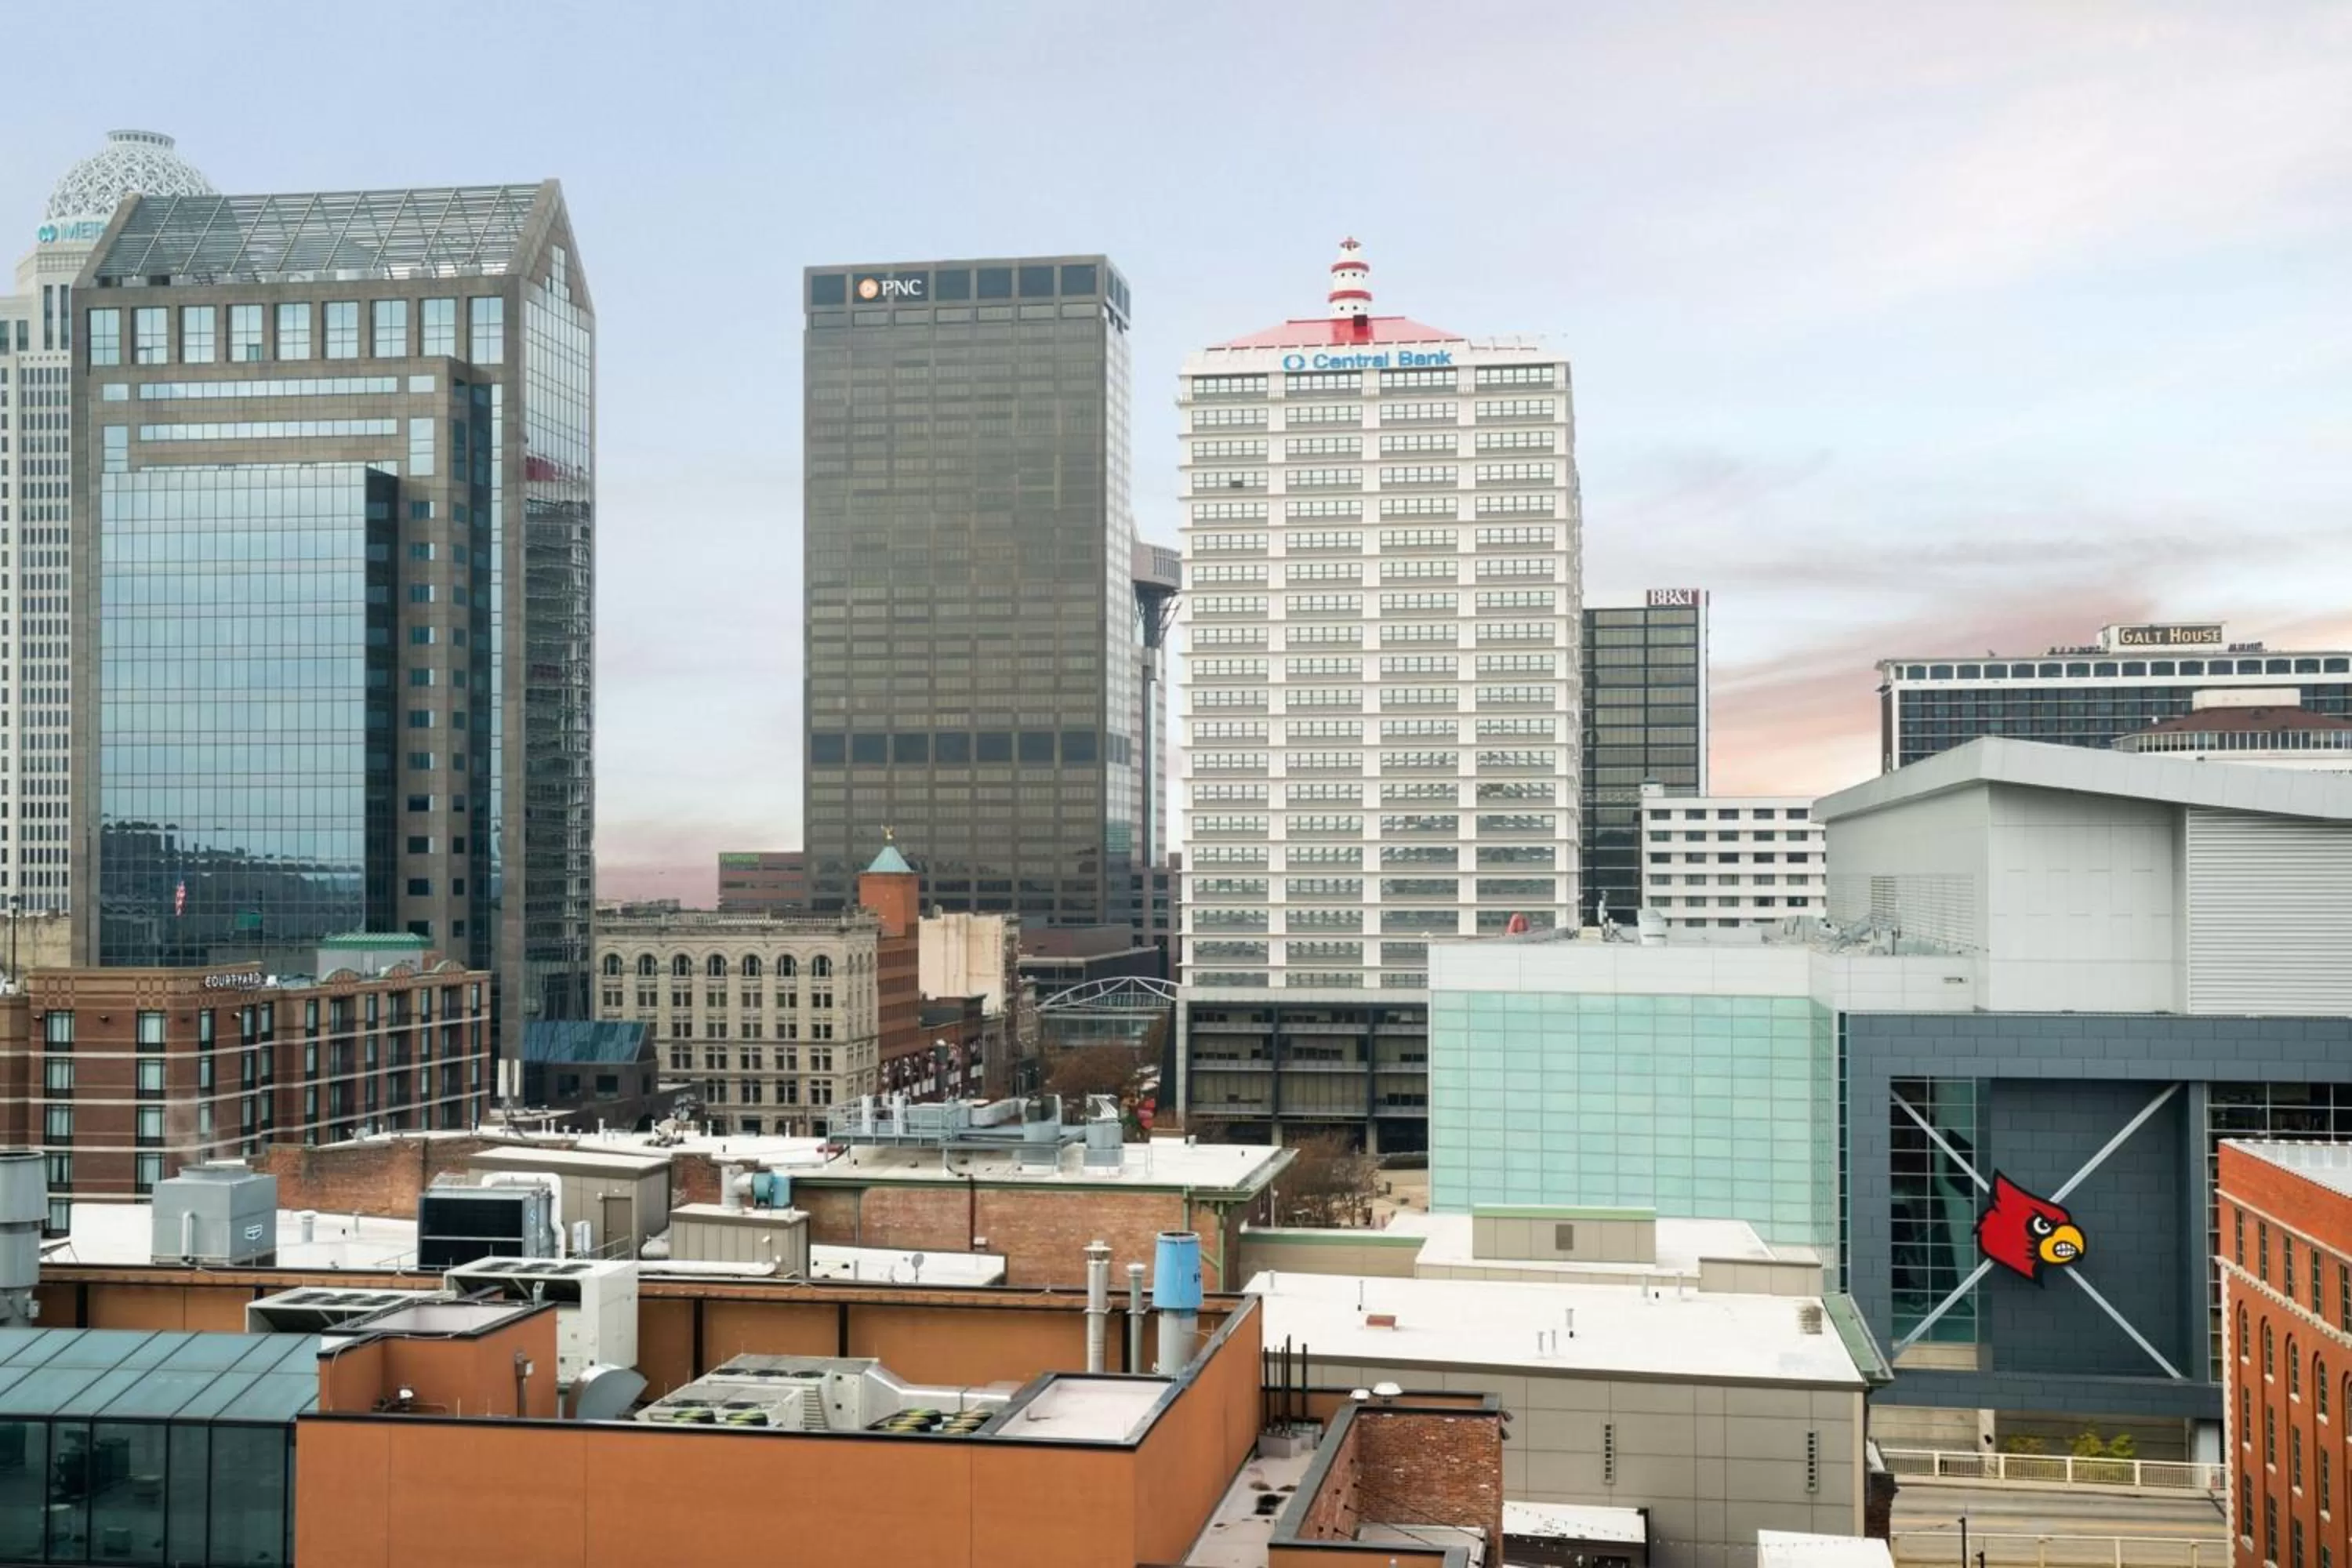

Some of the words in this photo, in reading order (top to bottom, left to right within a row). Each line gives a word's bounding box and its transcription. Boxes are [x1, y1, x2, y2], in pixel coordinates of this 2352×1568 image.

[880, 278, 922, 296] PNC
[1312, 351, 1389, 369] Central
[1398, 350, 1452, 366] Bank
[1651, 589, 1693, 605] BB&T
[2121, 628, 2162, 644] GALT
[2169, 627, 2221, 643] HOUSE
[205, 972, 261, 988] COURTYARD
